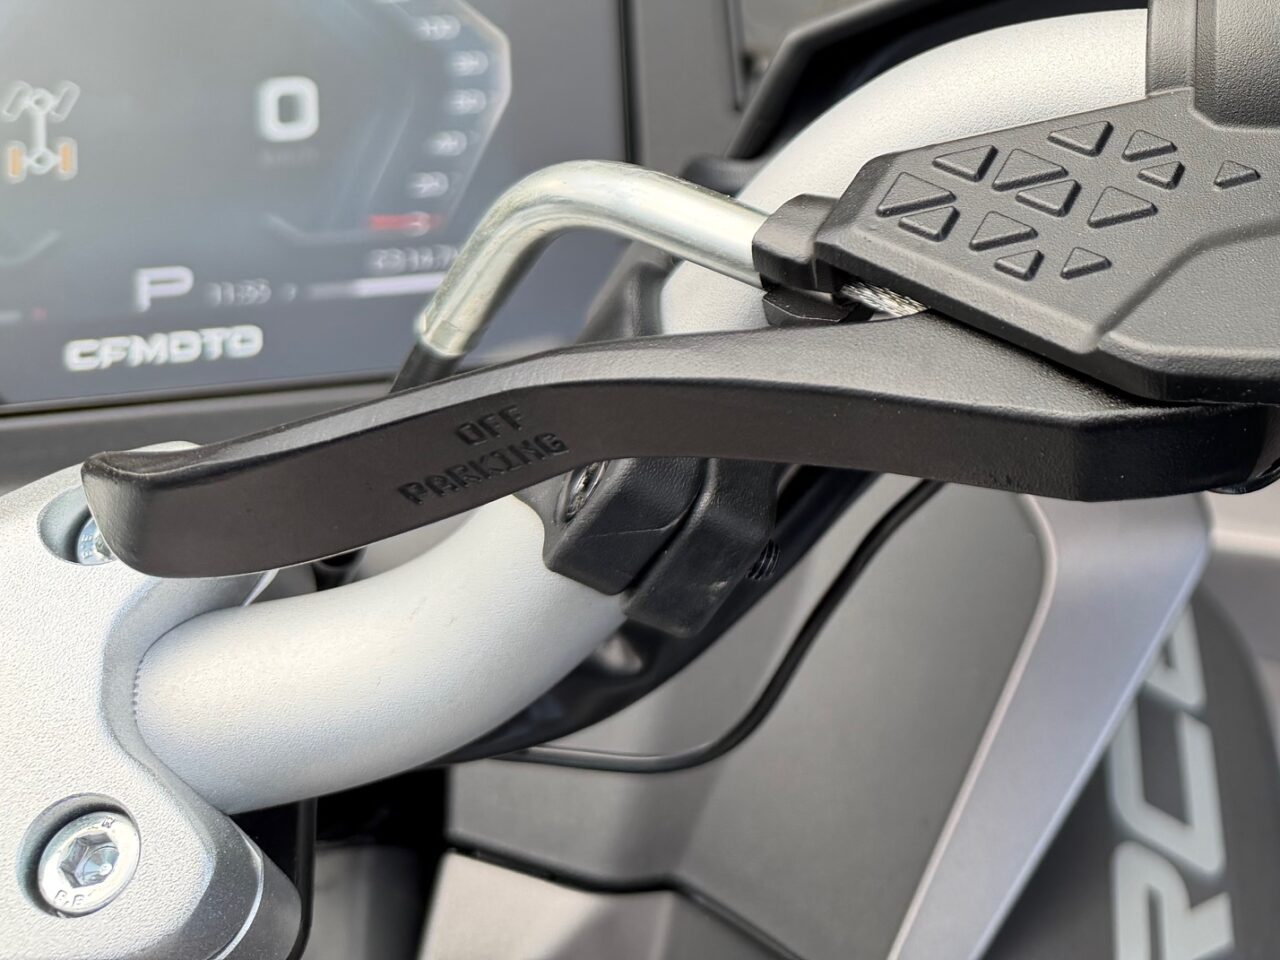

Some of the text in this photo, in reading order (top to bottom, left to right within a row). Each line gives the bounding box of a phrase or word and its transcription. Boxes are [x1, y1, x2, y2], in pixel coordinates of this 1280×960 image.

[256, 75, 320, 142] 0
[134, 265, 194, 313] P
[63, 323, 264, 372] CFMOTO
[455, 404, 522, 446] OFF
[397, 431, 570, 505] PARKING
